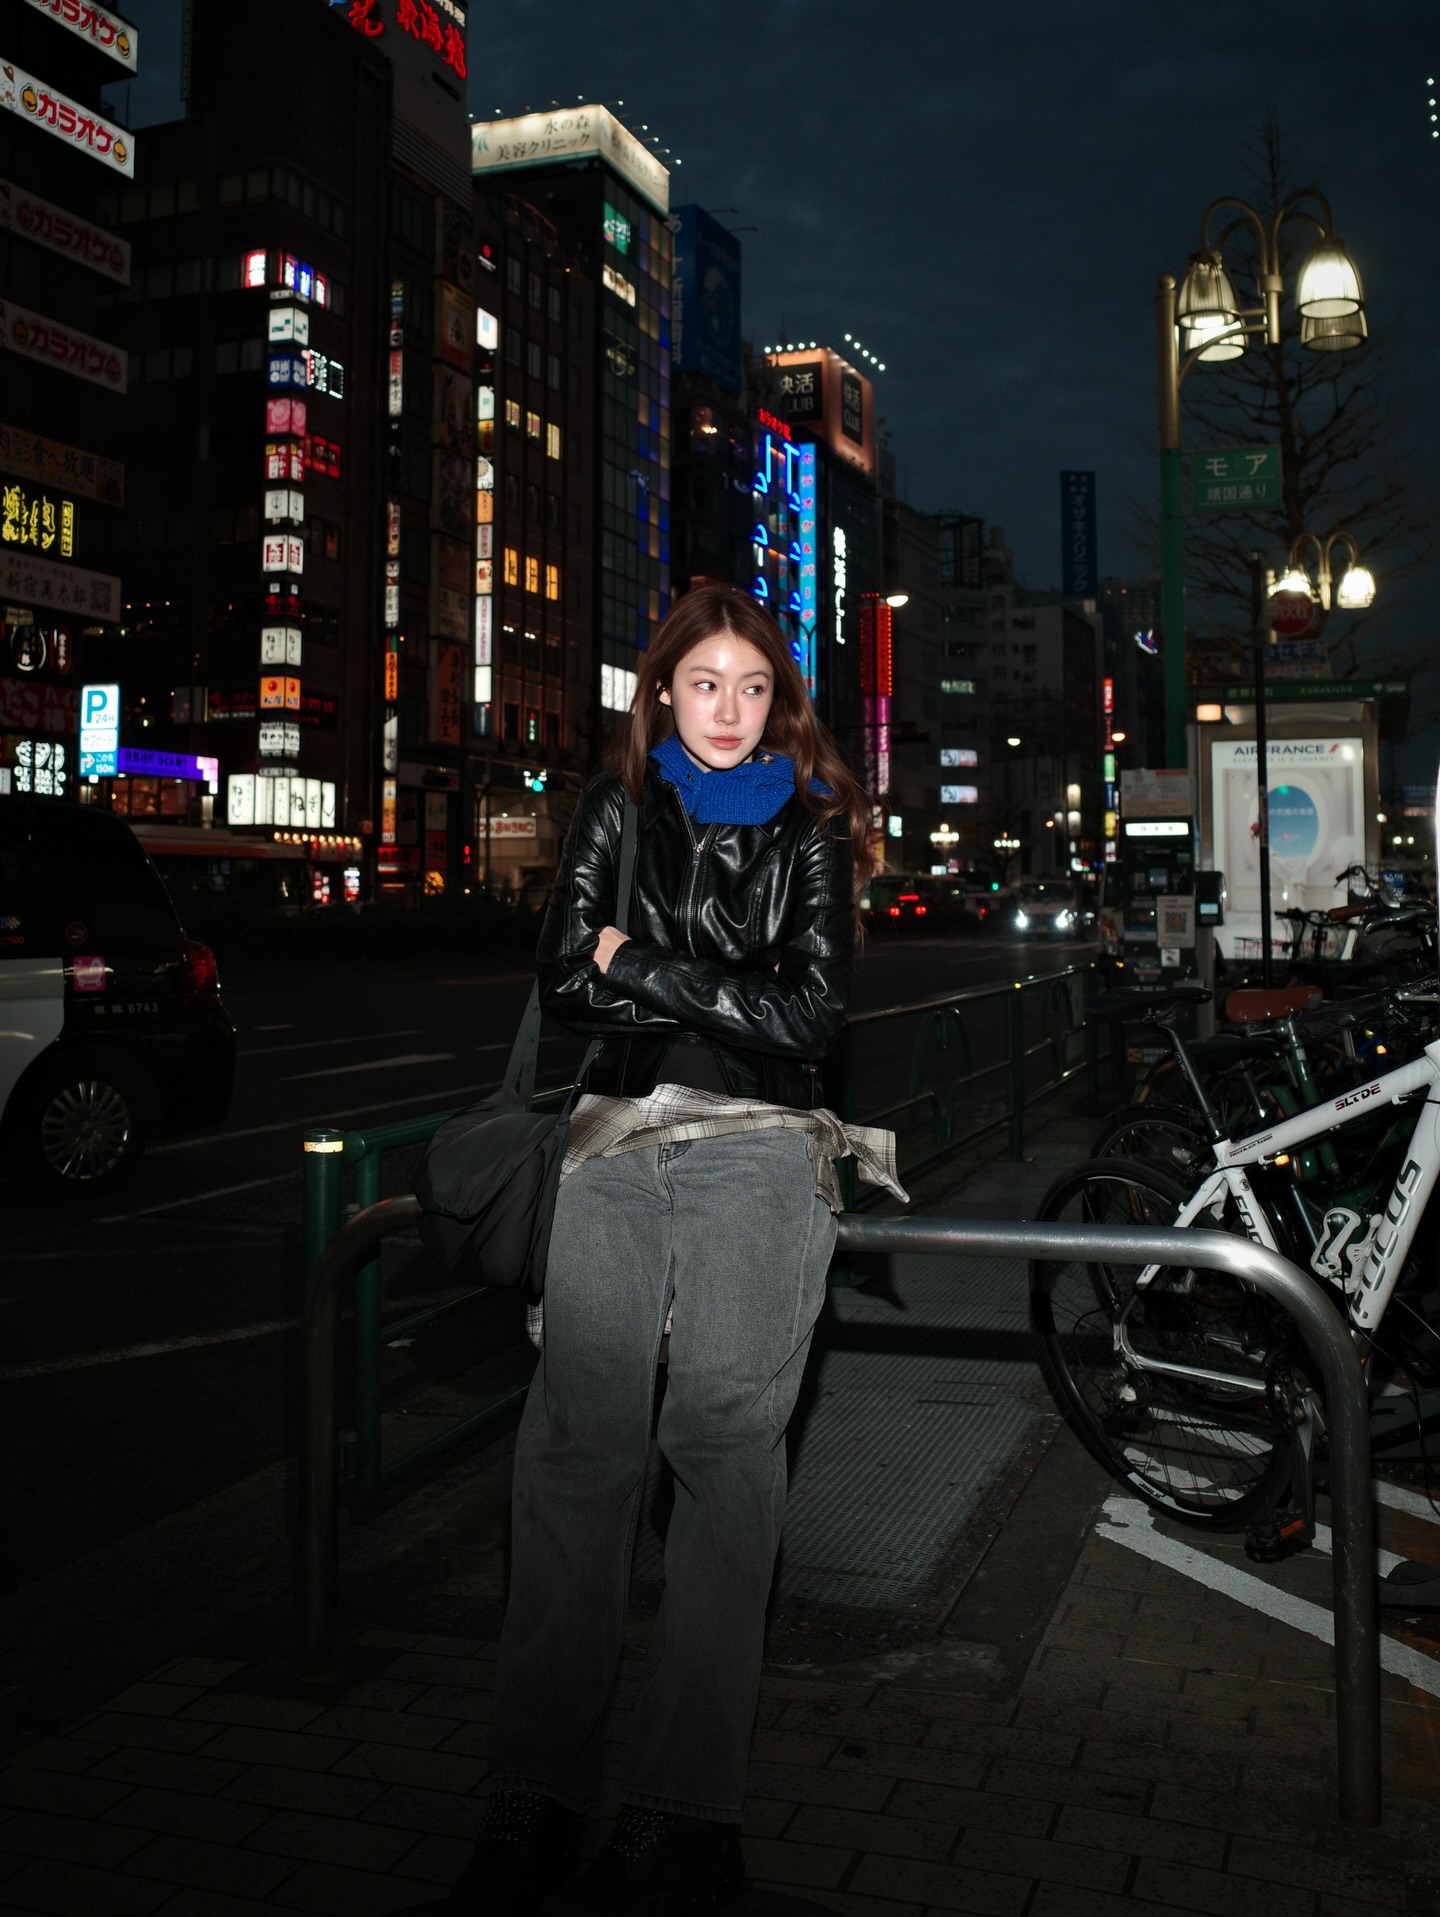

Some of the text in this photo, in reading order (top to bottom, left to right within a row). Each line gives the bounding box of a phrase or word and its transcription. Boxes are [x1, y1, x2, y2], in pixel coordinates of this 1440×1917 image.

[38, 93, 113, 153] カラオケ
[544, 113, 591, 135] 水の森
[496, 132, 591, 161] 美容クリニック
[34, 208, 110, 263] カラオケ
[30, 324, 107, 373] カラオケ
[1205, 454, 1268, 477] モア
[1207, 484, 1266, 501] 靖国通り
[86, 690, 107, 723] P
[264, 695, 282, 705] 松屋
[95, 754, 114, 763] この先
[95, 764, 114, 773] 150m
[128, 1002, 159, 1013] 6743
